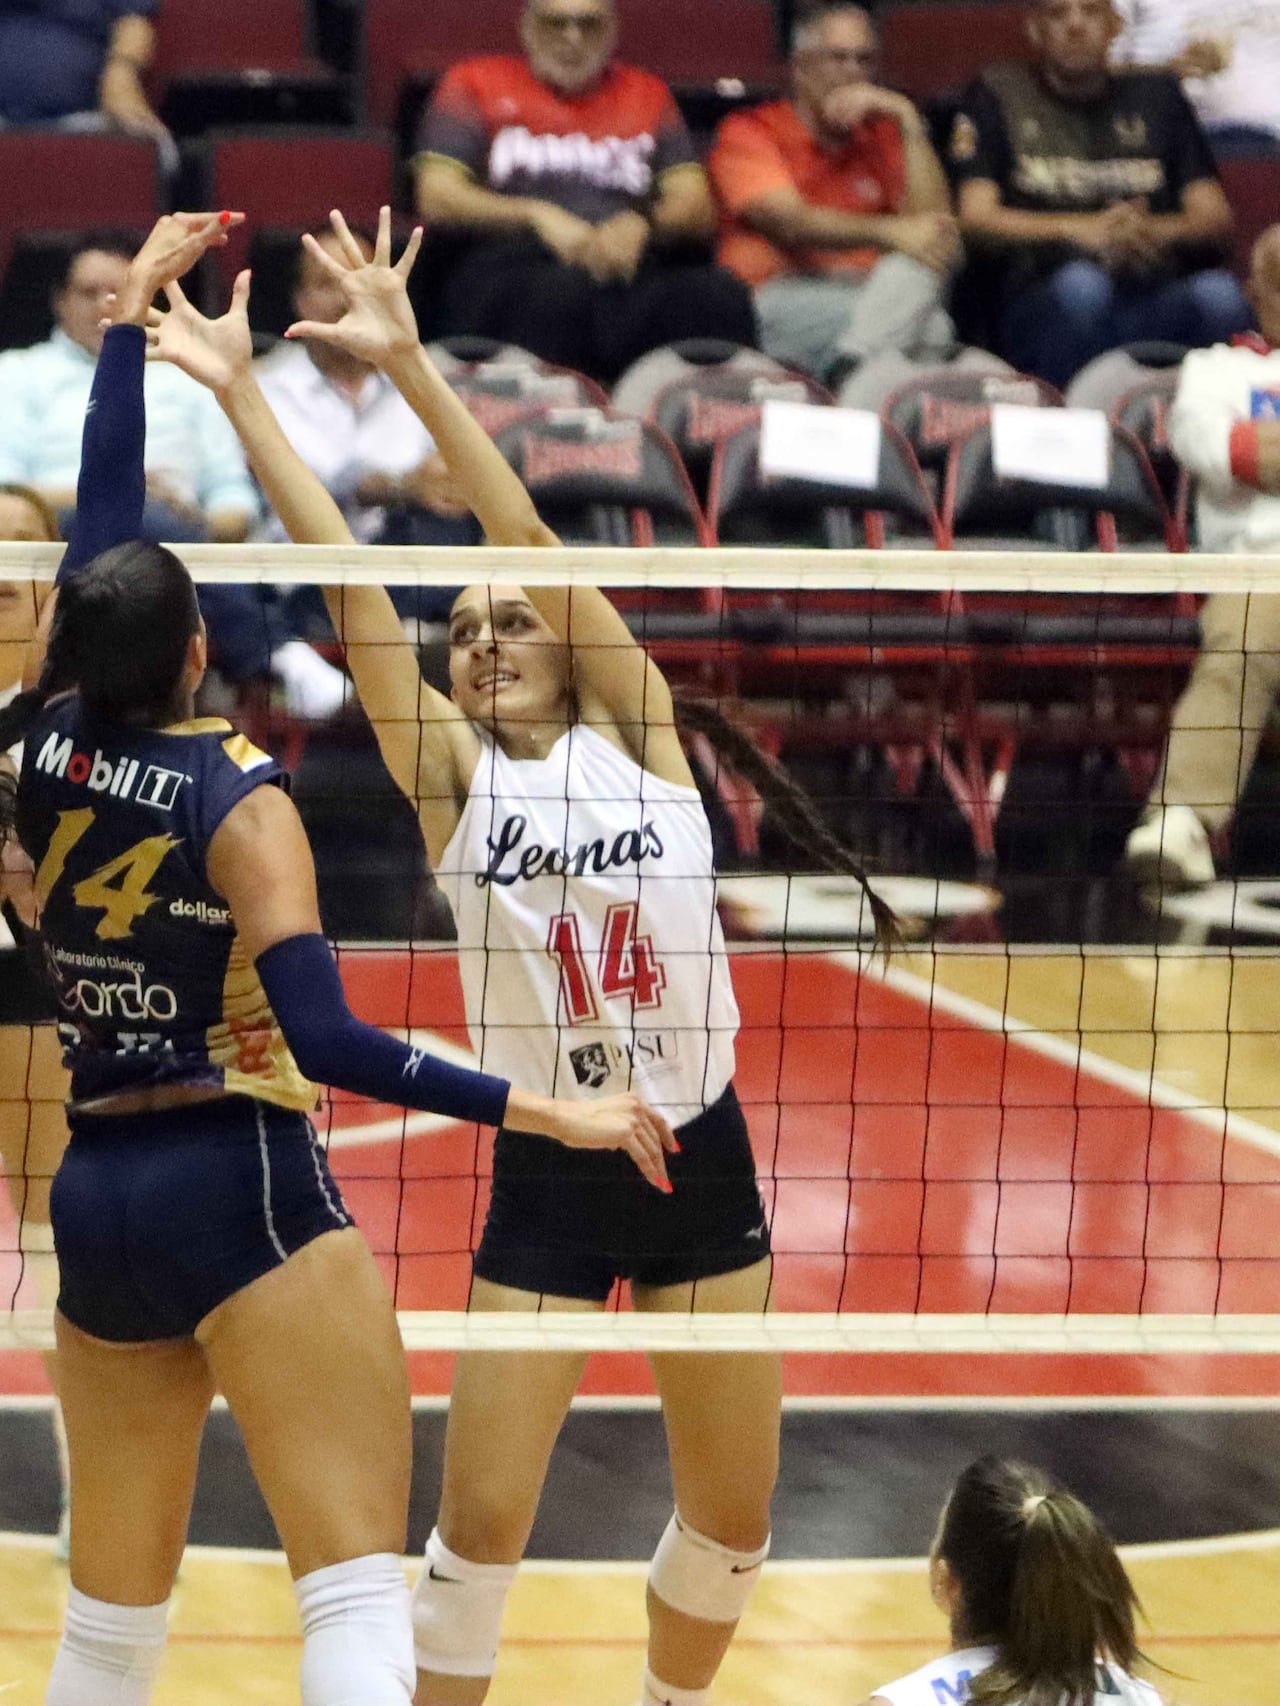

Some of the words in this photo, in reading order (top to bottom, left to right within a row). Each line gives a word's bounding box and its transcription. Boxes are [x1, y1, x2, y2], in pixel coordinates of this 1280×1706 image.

[35, 731, 140, 799] Mobil
[34, 806, 185, 939] 14
[474, 815, 665, 888] Leonas
[546, 901, 666, 1026] 14
